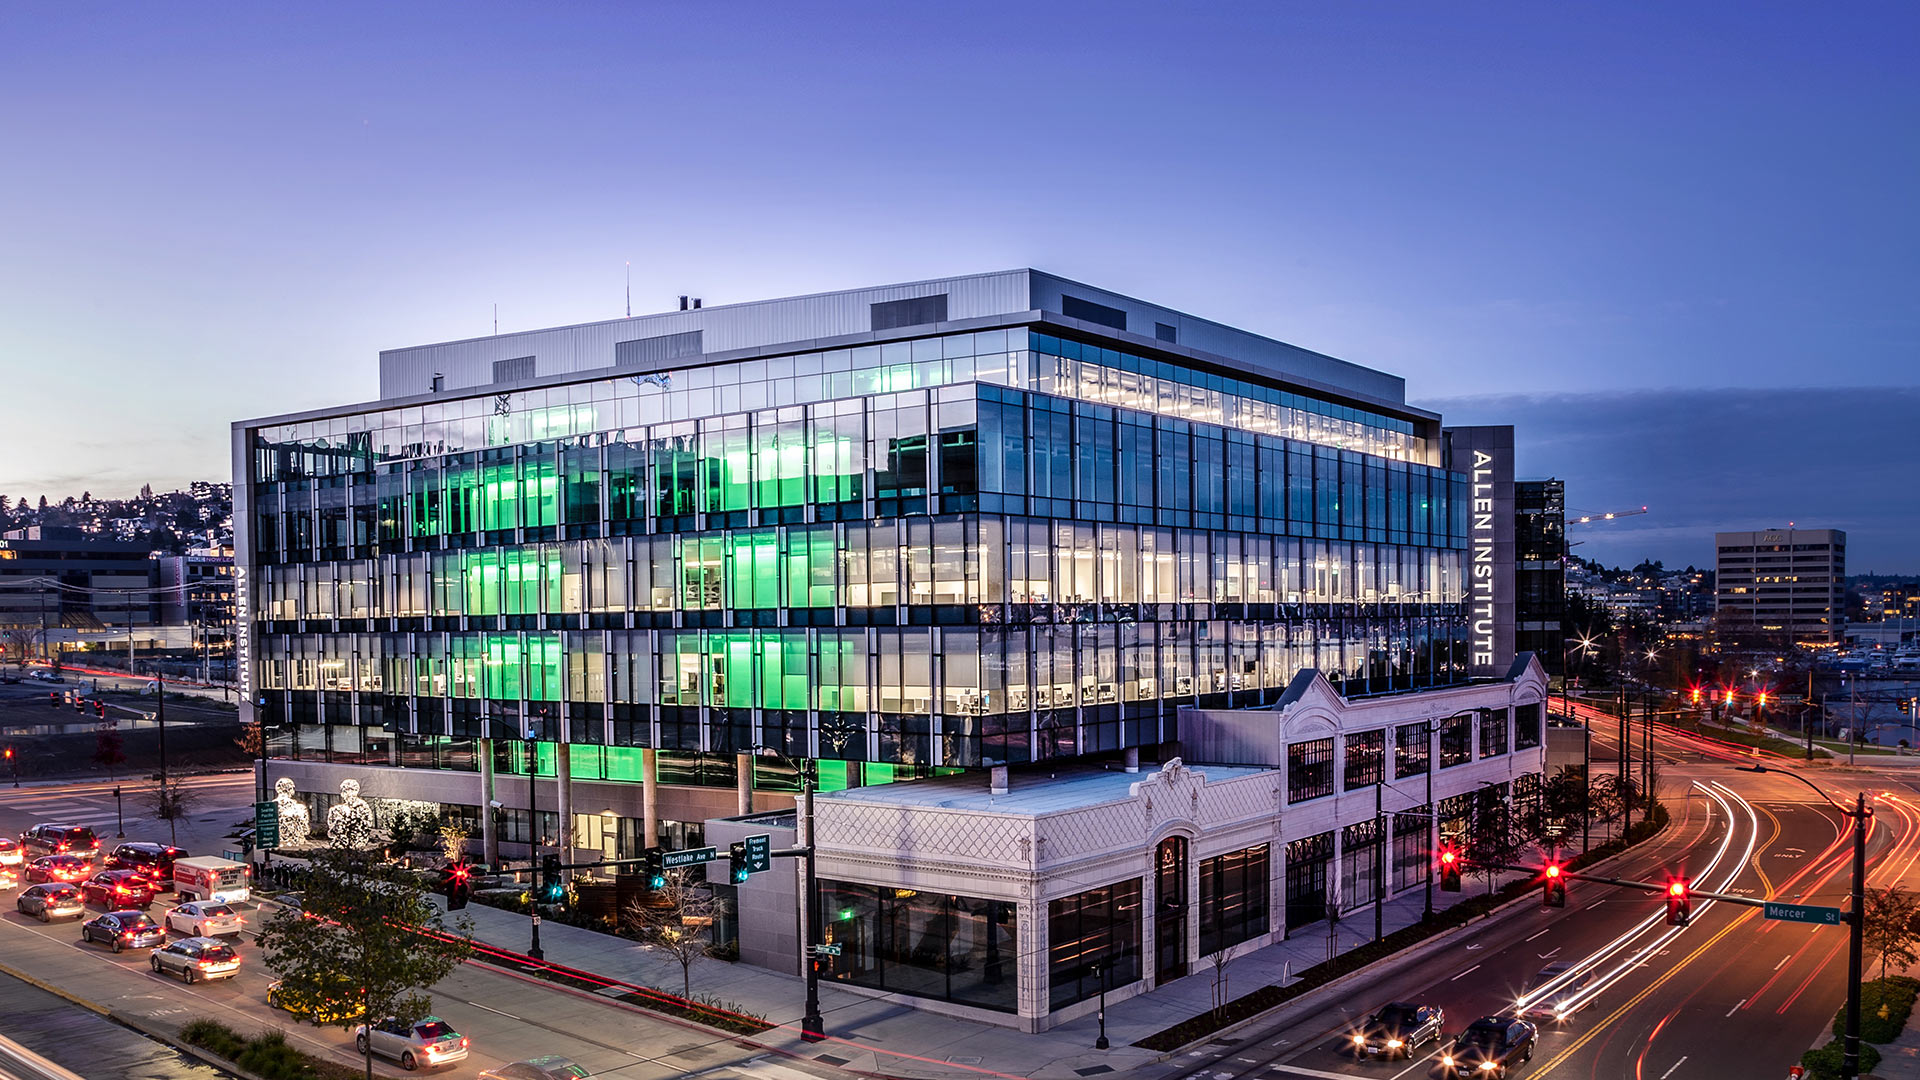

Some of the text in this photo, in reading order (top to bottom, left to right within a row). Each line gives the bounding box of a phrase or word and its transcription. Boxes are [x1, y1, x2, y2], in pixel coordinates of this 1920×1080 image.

[1473, 450, 1493, 665] ALLEN INSTITUTE
[236, 566, 250, 702] ALLEN INSTITUTE
[748, 837, 766, 845] Fremont
[665, 854, 694, 865] Westlake
[1769, 905, 1835, 922] Mercer St
